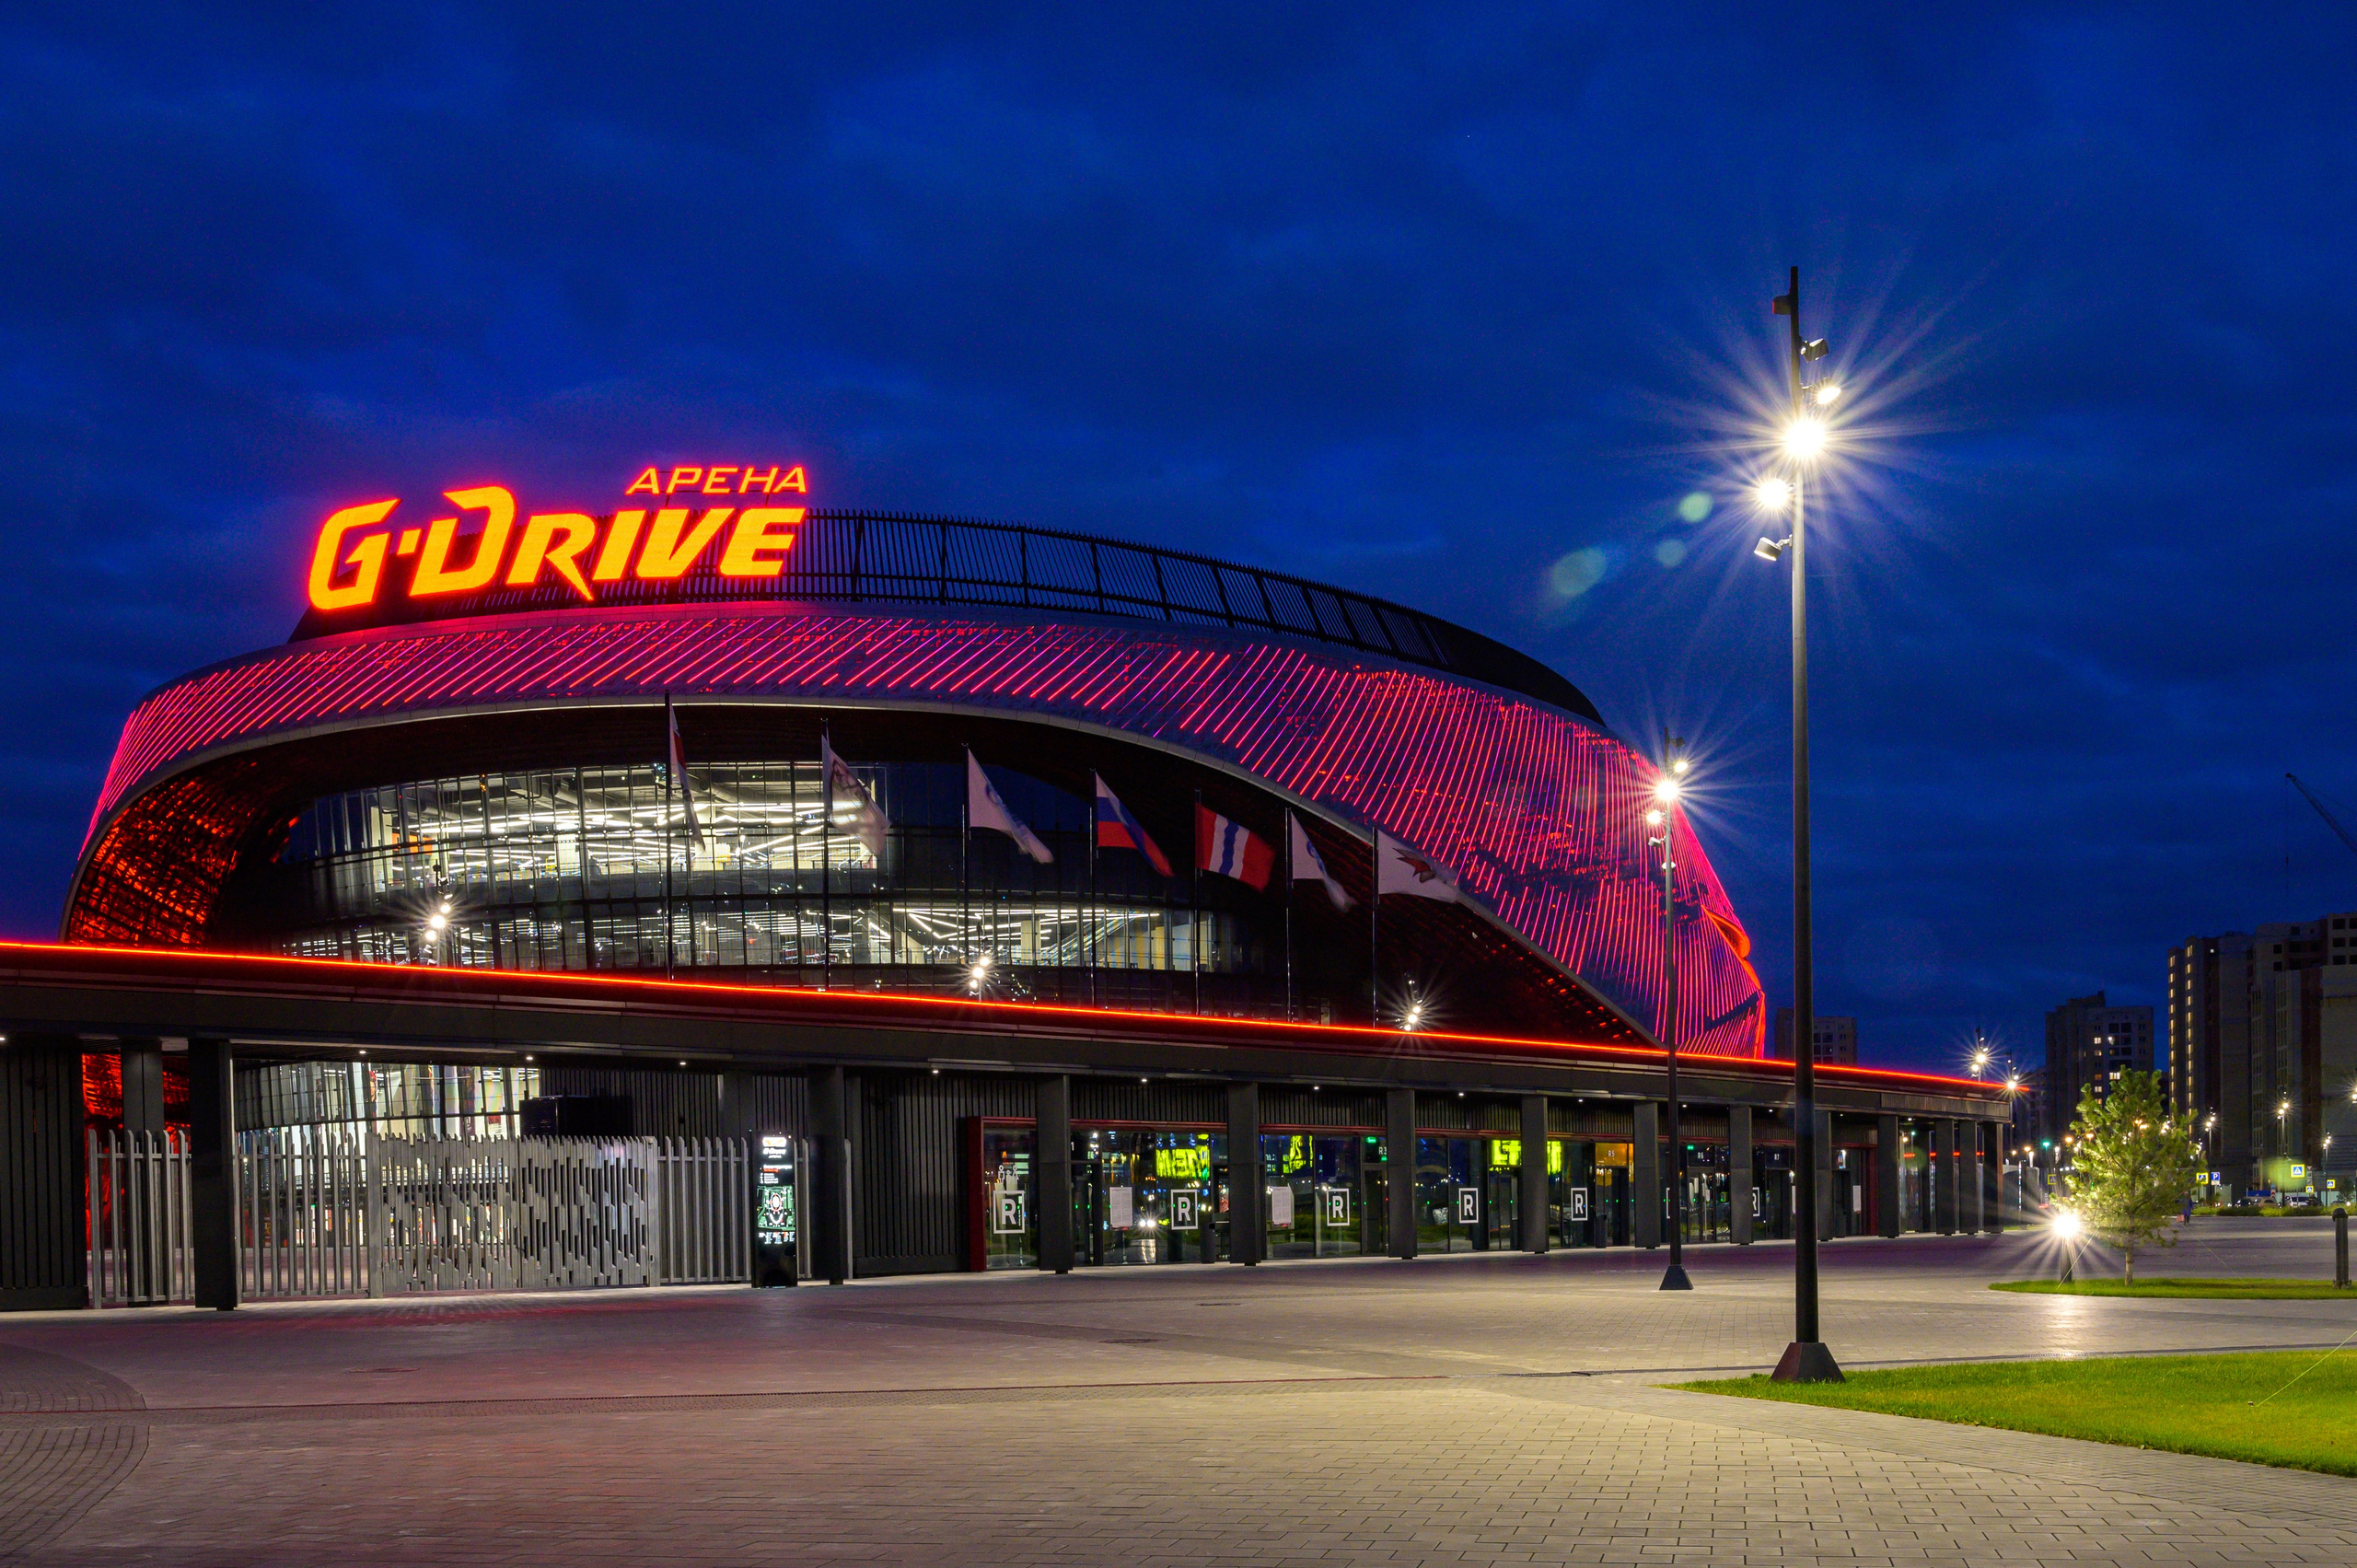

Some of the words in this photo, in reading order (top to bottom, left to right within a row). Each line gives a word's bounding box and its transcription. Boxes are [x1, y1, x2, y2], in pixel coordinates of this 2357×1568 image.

[625, 467, 807, 494] АРЕНА
[1001, 1199, 1016, 1225] R
[1178, 1197, 1190, 1222] R
[1332, 1196, 1344, 1218] R
[1464, 1194, 1473, 1216] R
[1575, 1193, 1584, 1214] R
